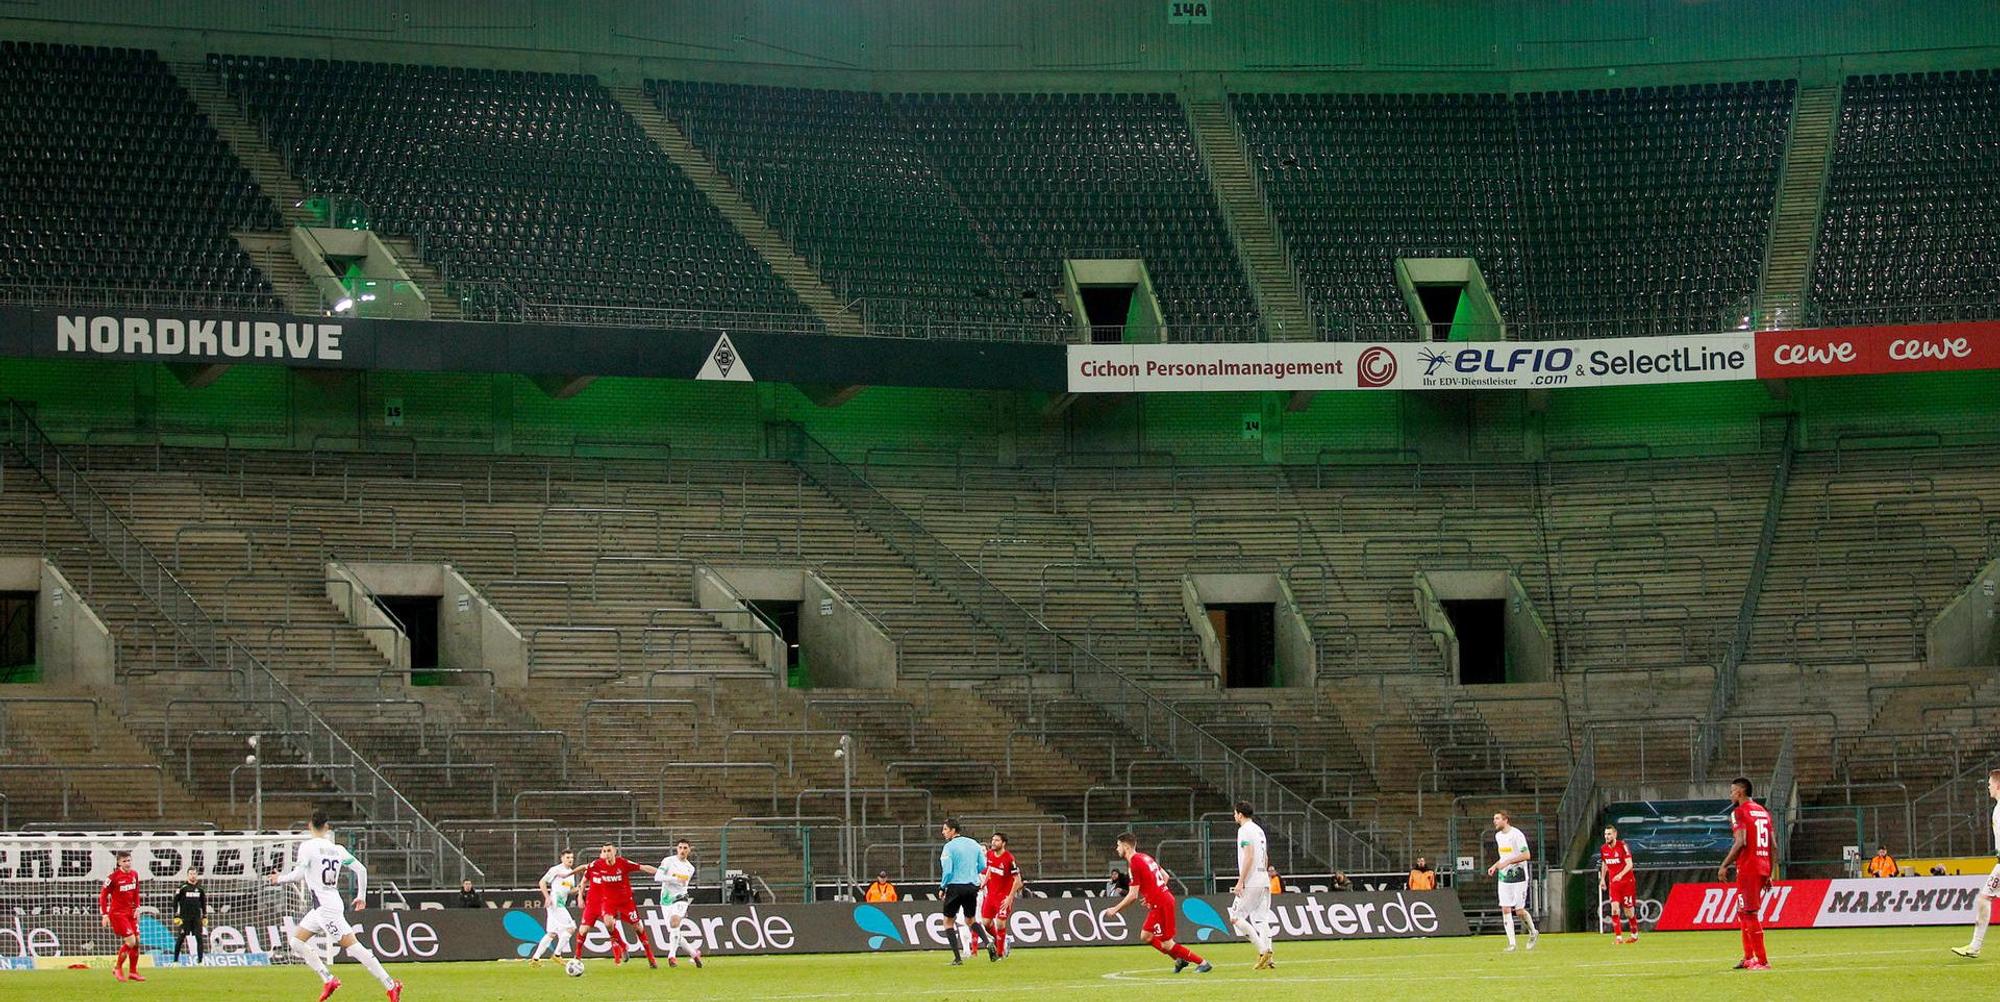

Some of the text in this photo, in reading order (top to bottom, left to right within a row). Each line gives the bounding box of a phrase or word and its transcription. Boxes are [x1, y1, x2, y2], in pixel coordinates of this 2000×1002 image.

[1173, 3, 1207, 16] 14A
[57, 315, 343, 360] NORDKURVE
[1889, 335, 1971, 361] cewe
[1575, 346, 1744, 377] & SelectLine
[1774, 341, 1856, 365] cewe
[1081, 360, 1343, 380] Cichon Personalmanagement
[1423, 377, 1517, 387] Ihr EDV-Dienstleister
[1530, 374, 1568, 385] .com
[1245, 421, 1259, 431] 14
[1755, 819, 1768, 847] 15
[1828, 888, 1980, 913] MAX-I-MUM
